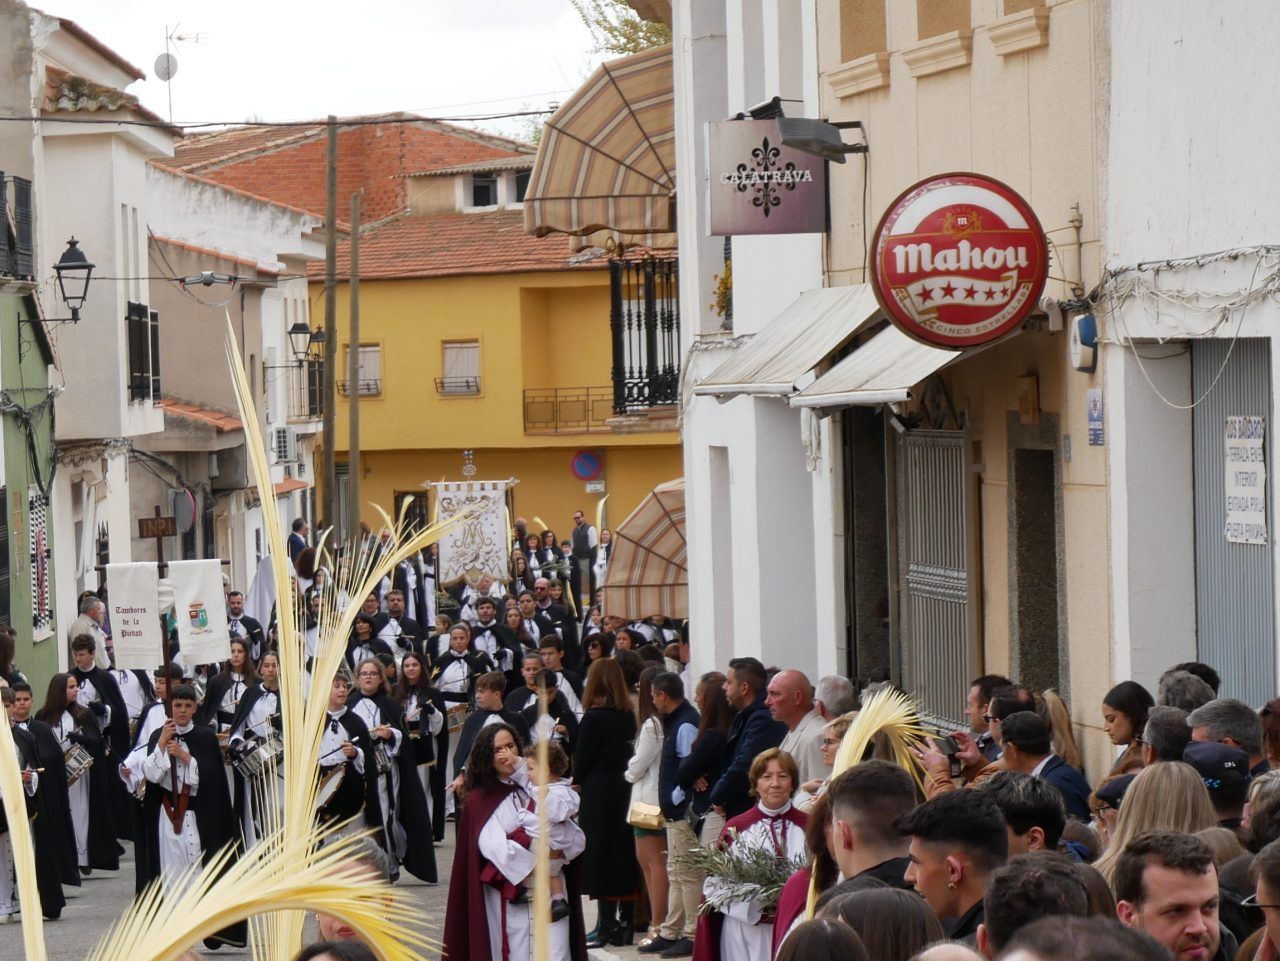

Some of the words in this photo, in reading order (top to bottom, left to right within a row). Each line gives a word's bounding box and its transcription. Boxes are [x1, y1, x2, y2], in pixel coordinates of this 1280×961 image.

[720, 170, 813, 184] CALATRAVA
[892, 239, 1029, 274] Mahou
[936, 325, 971, 335] CINCO
[975, 291, 1028, 333] ESTRELLAS
[144, 519, 172, 536] INRI
[121, 630, 142, 638] Piedad
